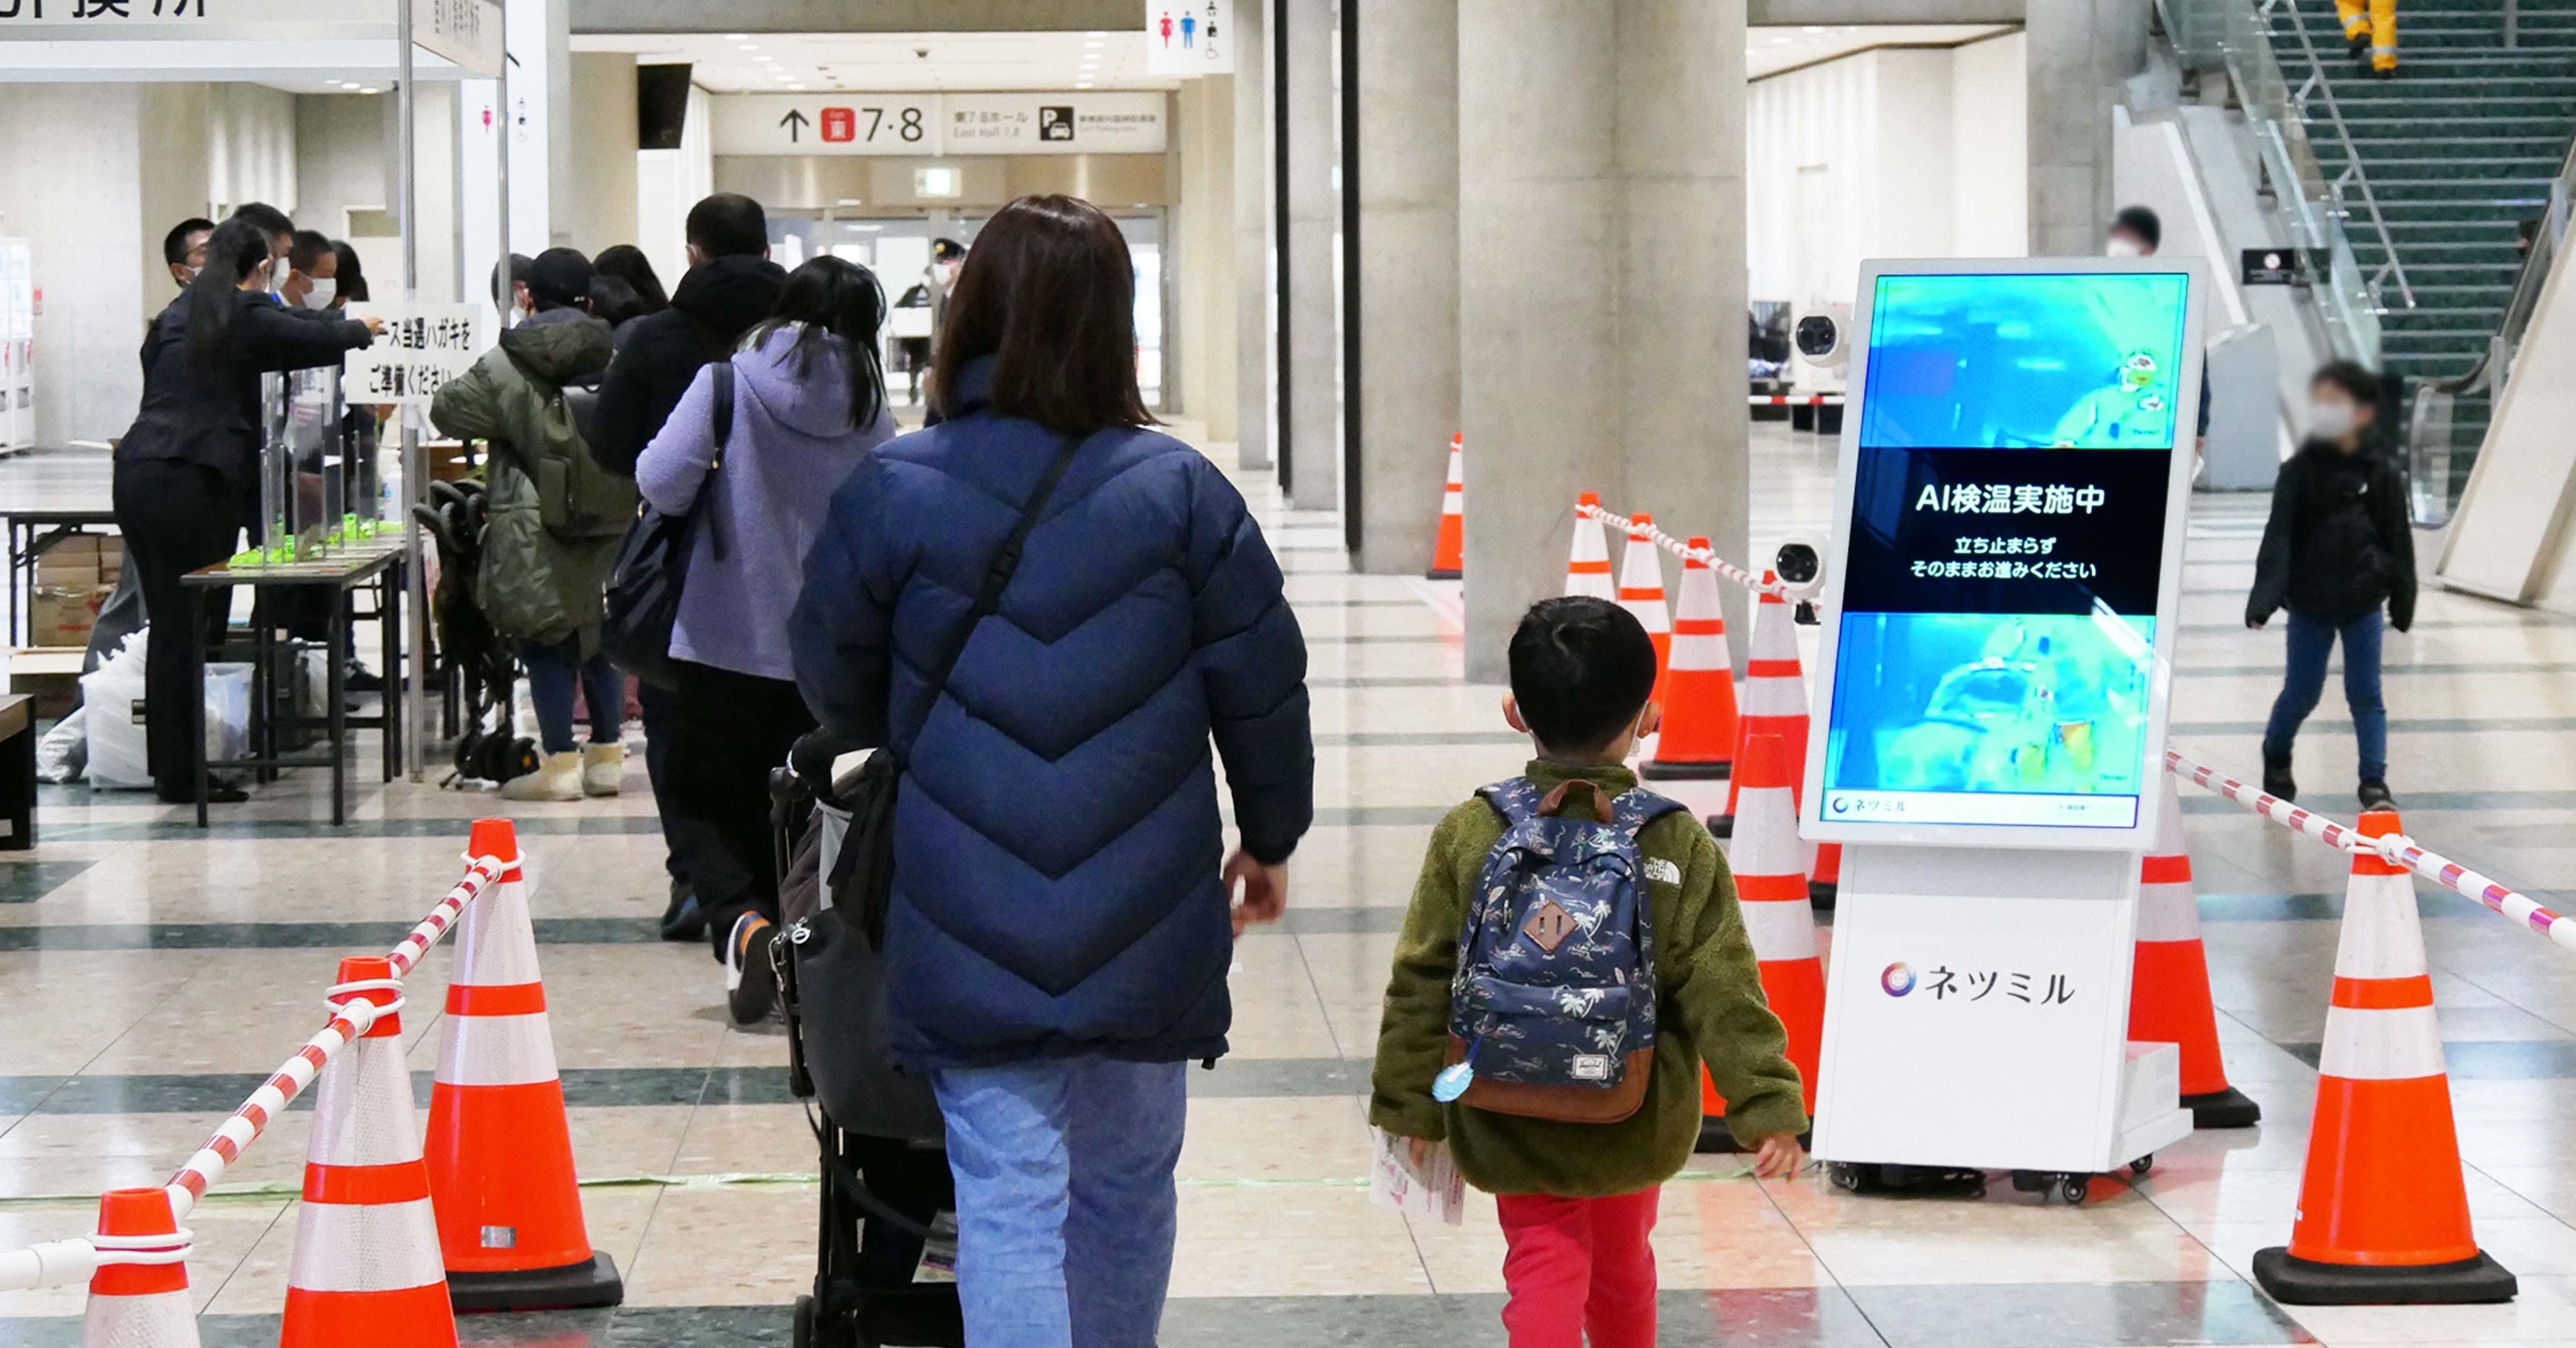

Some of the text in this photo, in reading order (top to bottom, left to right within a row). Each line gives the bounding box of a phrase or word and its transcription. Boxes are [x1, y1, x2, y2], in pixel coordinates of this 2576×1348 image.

[1915, 483, 2106, 514] AI検温実施中
[1953, 536, 2057, 555] 立ち止まらず
[1910, 561, 2097, 579] そのままお進みください
[1853, 798, 1907, 812] ネツミル
[1925, 966, 2076, 1005] ネツミル
